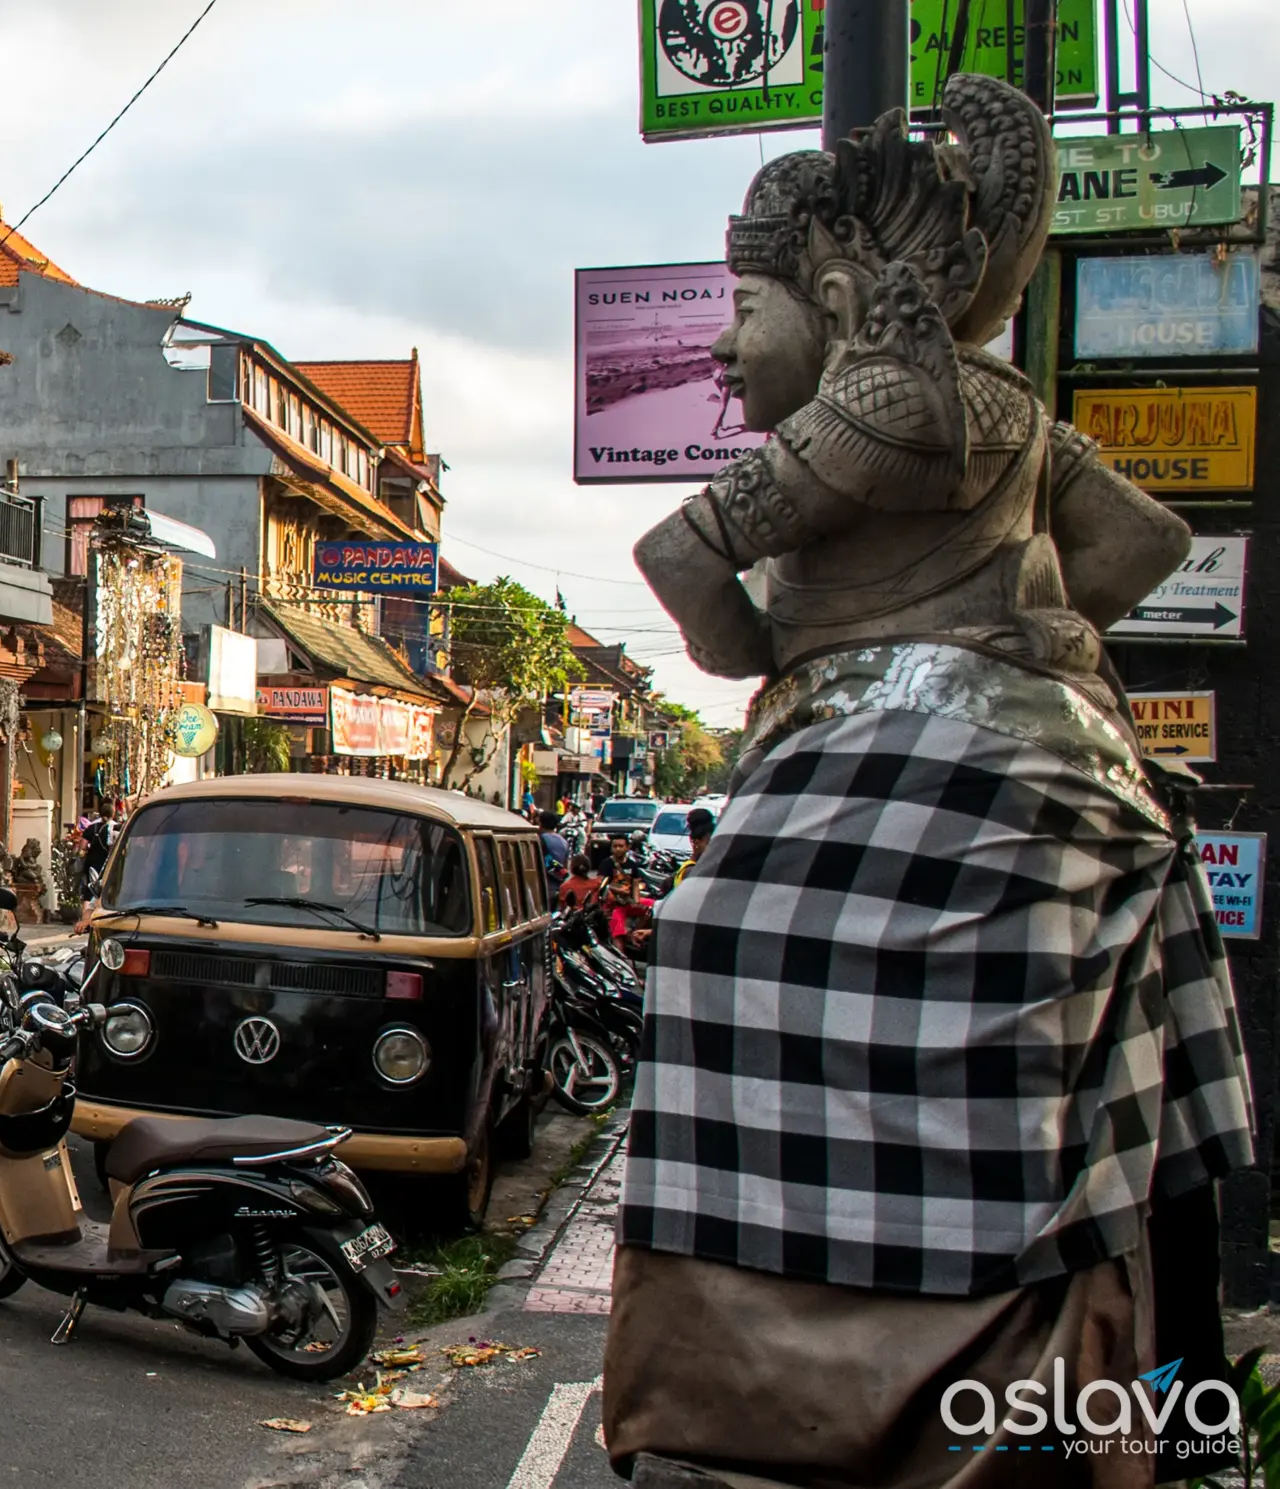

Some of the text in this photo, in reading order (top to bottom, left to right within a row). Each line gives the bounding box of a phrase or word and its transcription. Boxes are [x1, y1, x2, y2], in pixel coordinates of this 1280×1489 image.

[976, 20, 1079, 48] REGN
[656, 101, 700, 118] BEST
[1114, 143, 1161, 164] TO
[1138, 202, 1199, 219] UBUD
[588, 287, 725, 306] SUEN NOAJ
[1089, 401, 1239, 448] ARJUNA
[588, 446, 679, 466] Vintage
[1114, 457, 1209, 481] HOUSE
[342, 547, 435, 568] PANDAWA
[317, 572, 433, 585] MUSIC CENTRE
[1171, 582, 1239, 597] Treatment
[1143, 610, 1183, 620] meter
[272, 691, 324, 707] PANDAWA
[1161, 722, 1210, 738] SERVICE
[1226, 895, 1252, 906] WI-FI
